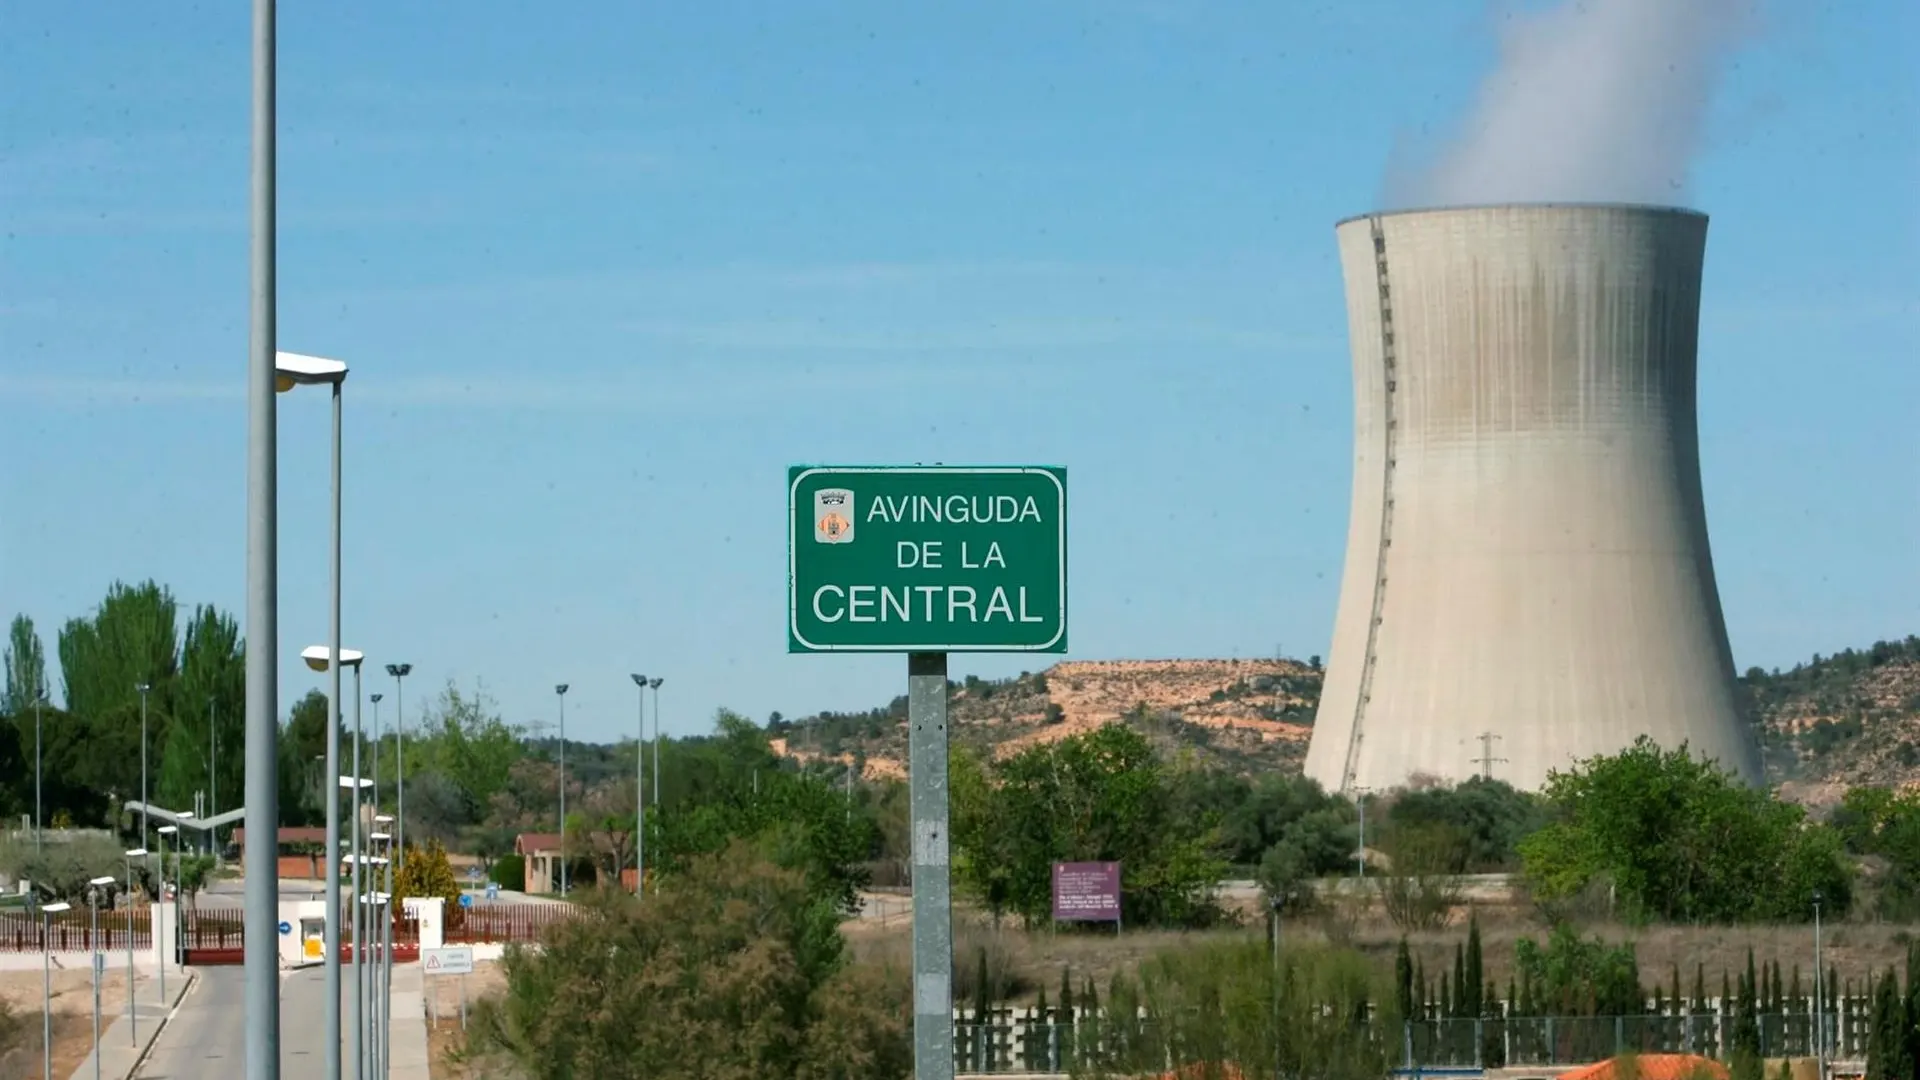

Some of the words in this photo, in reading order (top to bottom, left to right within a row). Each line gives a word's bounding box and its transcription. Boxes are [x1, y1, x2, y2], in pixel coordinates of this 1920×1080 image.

[867, 495, 1041, 523] AVINGUDA
[897, 541, 943, 568] DE
[962, 541, 1006, 568] LA
[812, 584, 1043, 623] CENTRAL
